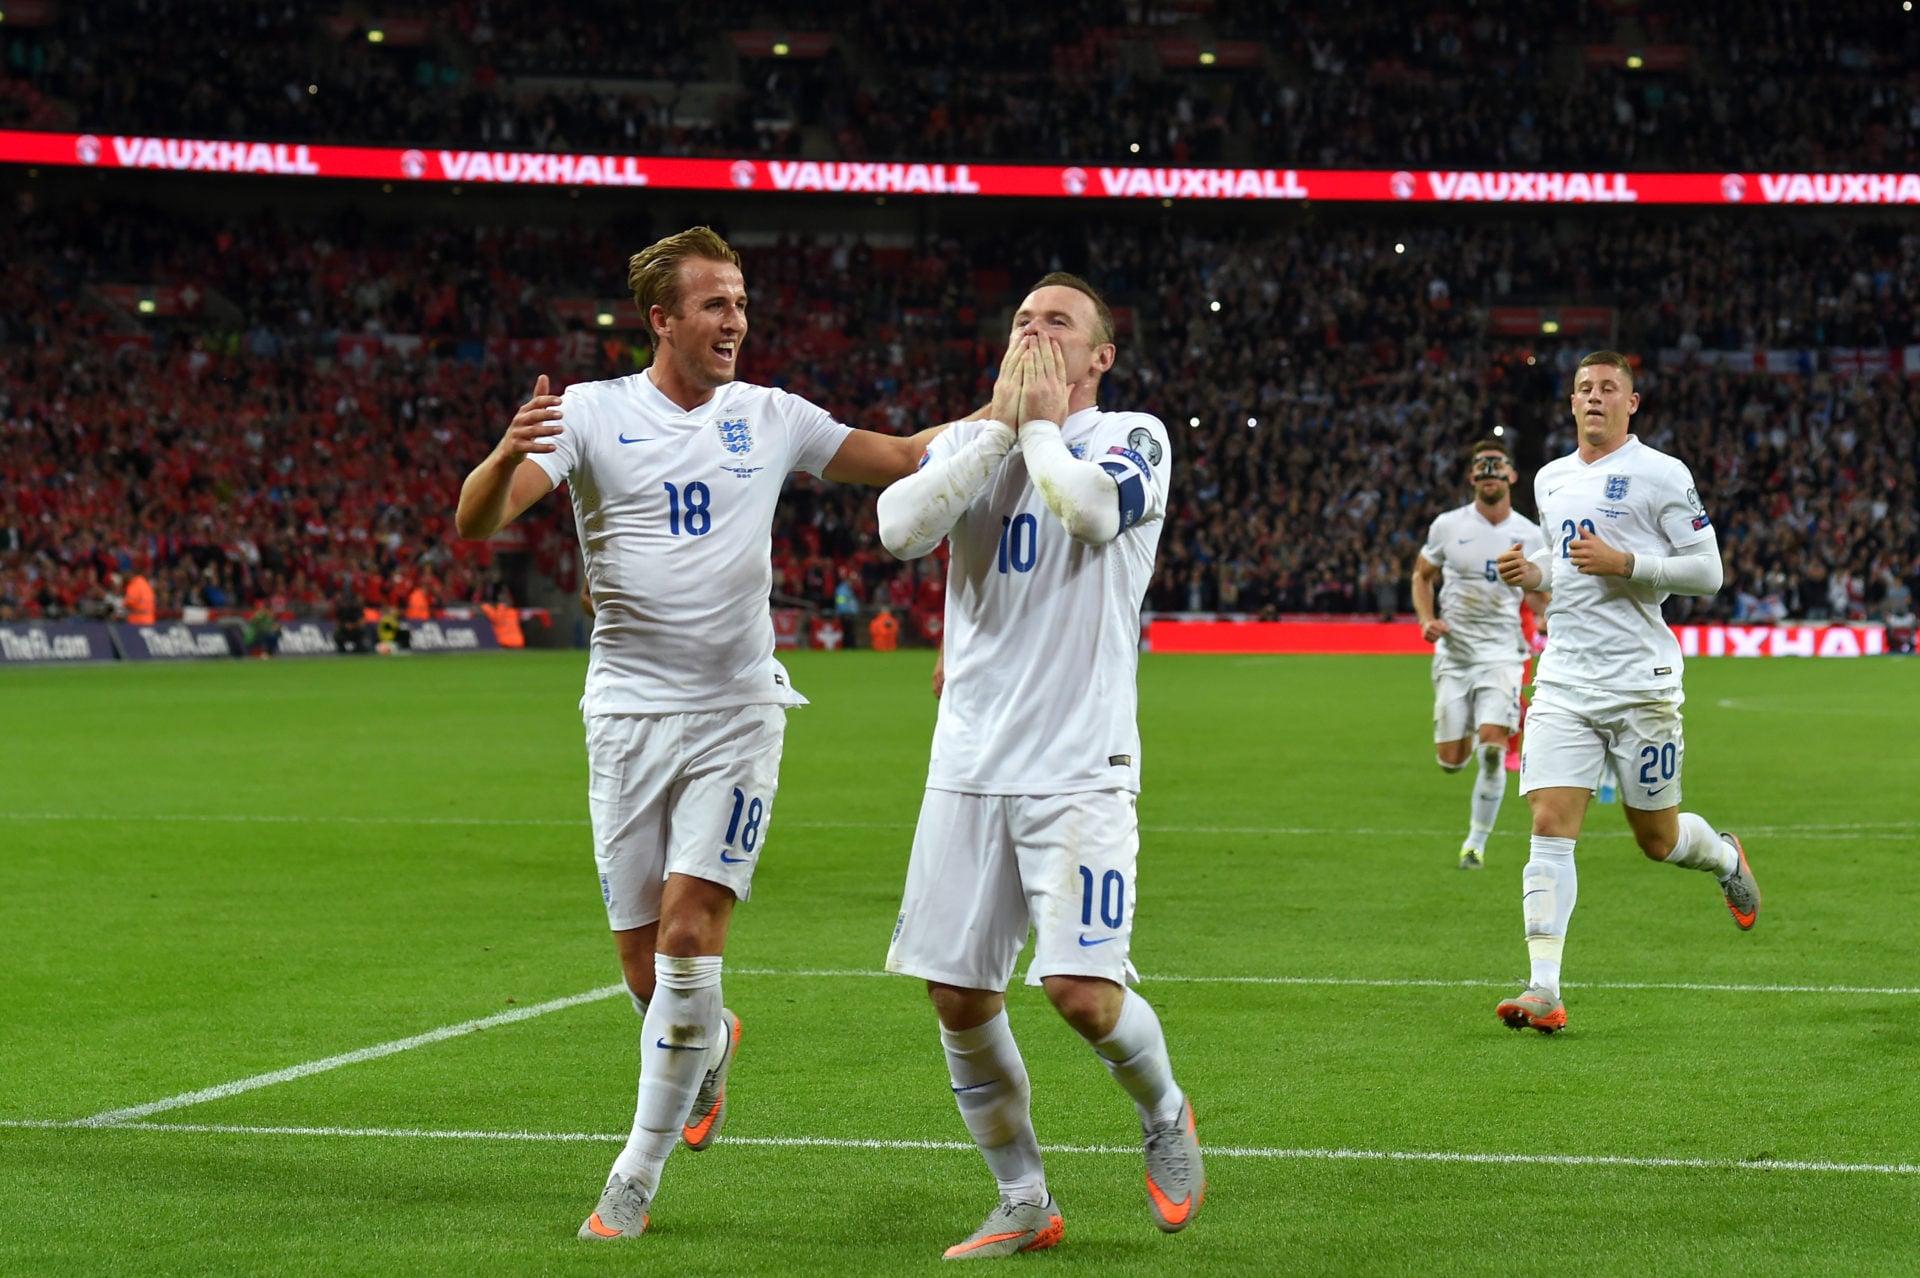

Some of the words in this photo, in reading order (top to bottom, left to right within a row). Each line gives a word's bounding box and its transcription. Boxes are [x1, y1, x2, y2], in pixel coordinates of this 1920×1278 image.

[113, 137, 318, 174] VAUXHALL
[439, 151, 646, 185] VAUXHALL
[768, 161, 979, 194] VAUXHALL
[1100, 167, 1307, 198] VAUXHALL
[1428, 171, 1637, 202] VAUXHALL
[664, 481, 711, 536] 18
[999, 513, 1037, 574] 10
[1486, 559, 1498, 583] 5
[1681, 627, 1883, 657] UXHAL
[1640, 742, 1676, 783] 20
[725, 787, 763, 853] 18
[1079, 865, 1124, 929] 10
